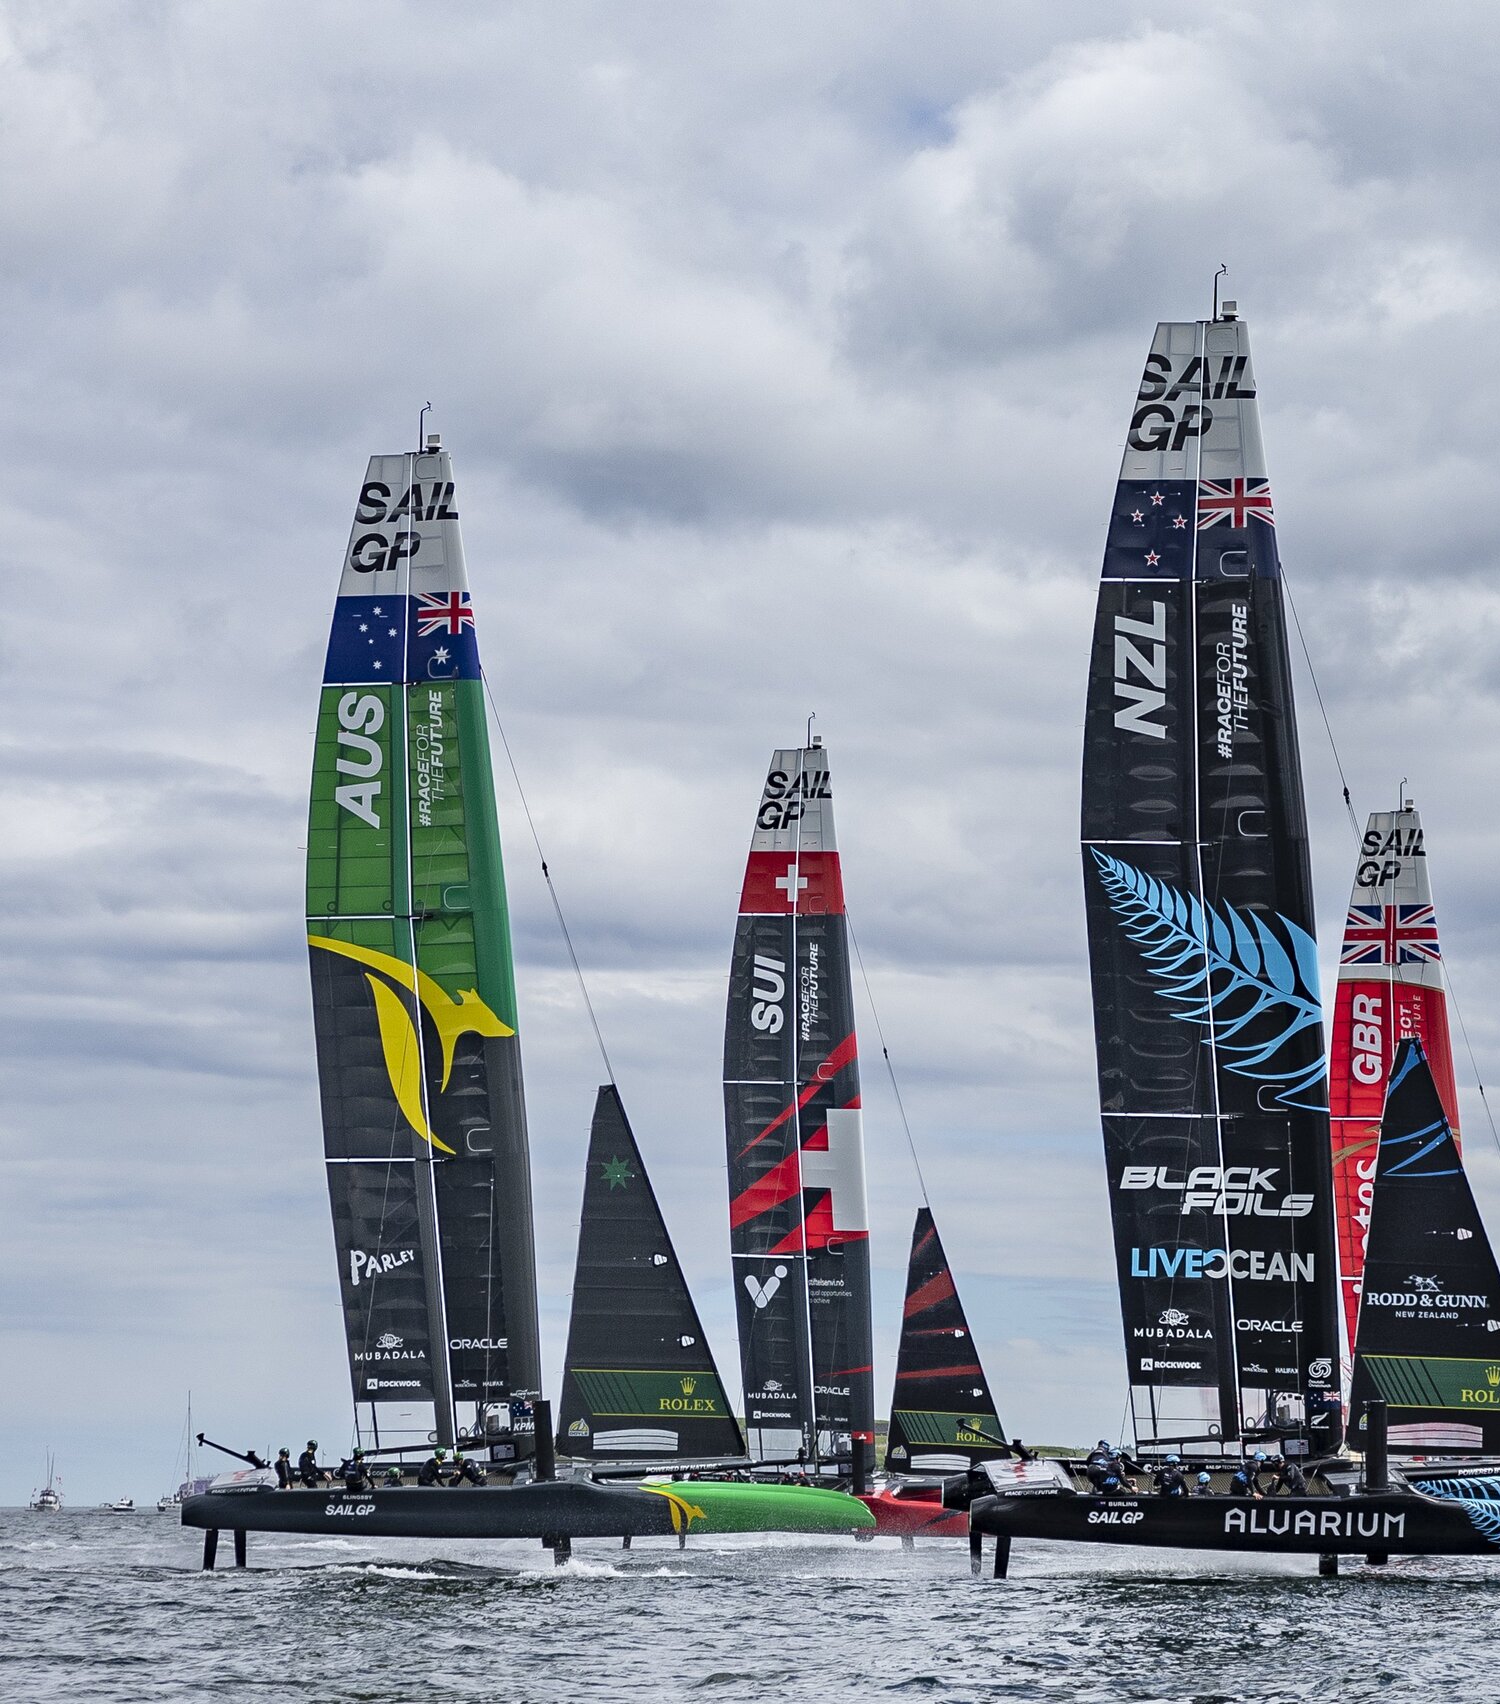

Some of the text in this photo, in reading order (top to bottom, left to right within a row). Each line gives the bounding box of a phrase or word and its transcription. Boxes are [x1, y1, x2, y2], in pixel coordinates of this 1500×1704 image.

[1136, 354, 1256, 401] SAIL
[1127, 404, 1213, 451] GP
[354, 481, 459, 524] SAIL
[350, 531, 421, 573] GP
[1114, 601, 1167, 739] NZL
[1232, 605, 1247, 732] THEFUTURE
[1217, 642, 1232, 759] #RACEFOR
[335, 691, 385, 829] AUS
[431, 690, 442, 803] THEFUTURE
[419, 724, 431, 827] #RACEFOR
[764, 771, 833, 799] SAIL
[757, 801, 805, 830] GP
[1361, 829, 1426, 857] SAIL
[1357, 861, 1400, 887] GP
[751, 954, 786, 1034] SUI
[809, 942, 819, 1025] THEFUTURE
[801, 966, 810, 1041] #RACEFOR
[1352, 994, 1382, 1084] GBR
[1120, 1166, 1280, 1191] BLACK
[1181, 1192, 1315, 1217] FOILS
[1367, 1292, 1487, 1308] RODD & GUNN
[1237, 1319, 1303, 1332] ORACLE
[1418, 1311, 1459, 1319] ZEALAND
[450, 1338, 508, 1350] ORACLE
[1134, 1327, 1213, 1339] MUBADALA
[355, 1350, 425, 1361] MUBADALA
[1154, 1361, 1201, 1369] ROCKWOOL
[659, 1398, 716, 1411] ROLEX
[814, 1386, 850, 1396] ORACLE
[513, 1422, 535, 1431] KPM
[1458, 1467, 1493, 1476] POWERED
[325, 1505, 376, 1516] SAILGP
[1088, 1511, 1144, 1524] SAILGP
[1224, 1507, 1405, 1538] ALVARIUM
